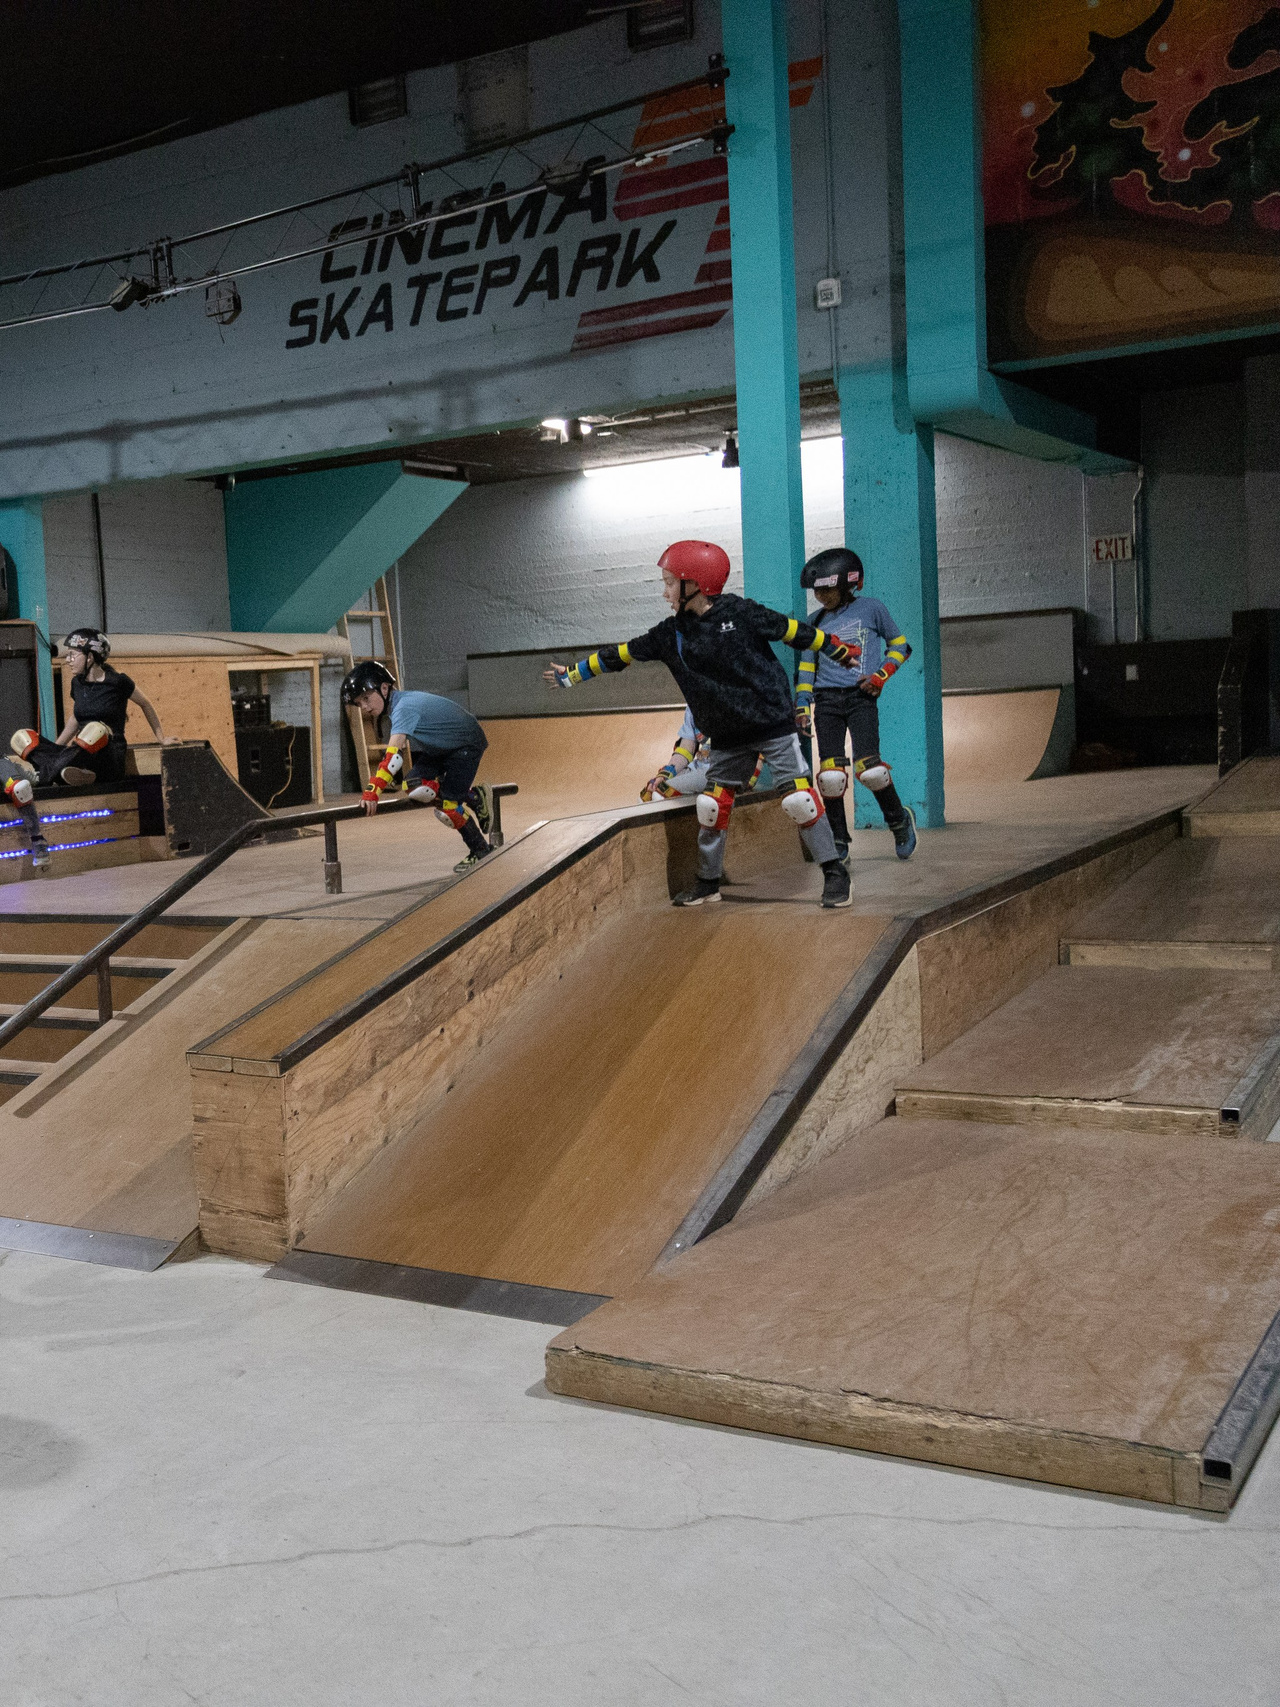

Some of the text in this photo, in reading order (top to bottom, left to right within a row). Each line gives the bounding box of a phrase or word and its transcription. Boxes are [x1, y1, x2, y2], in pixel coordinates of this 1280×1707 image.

[319, 156, 608, 284] CINEMA
[285, 219, 678, 350] SKATEPARK
[1095, 537, 1128, 561] EXIT
